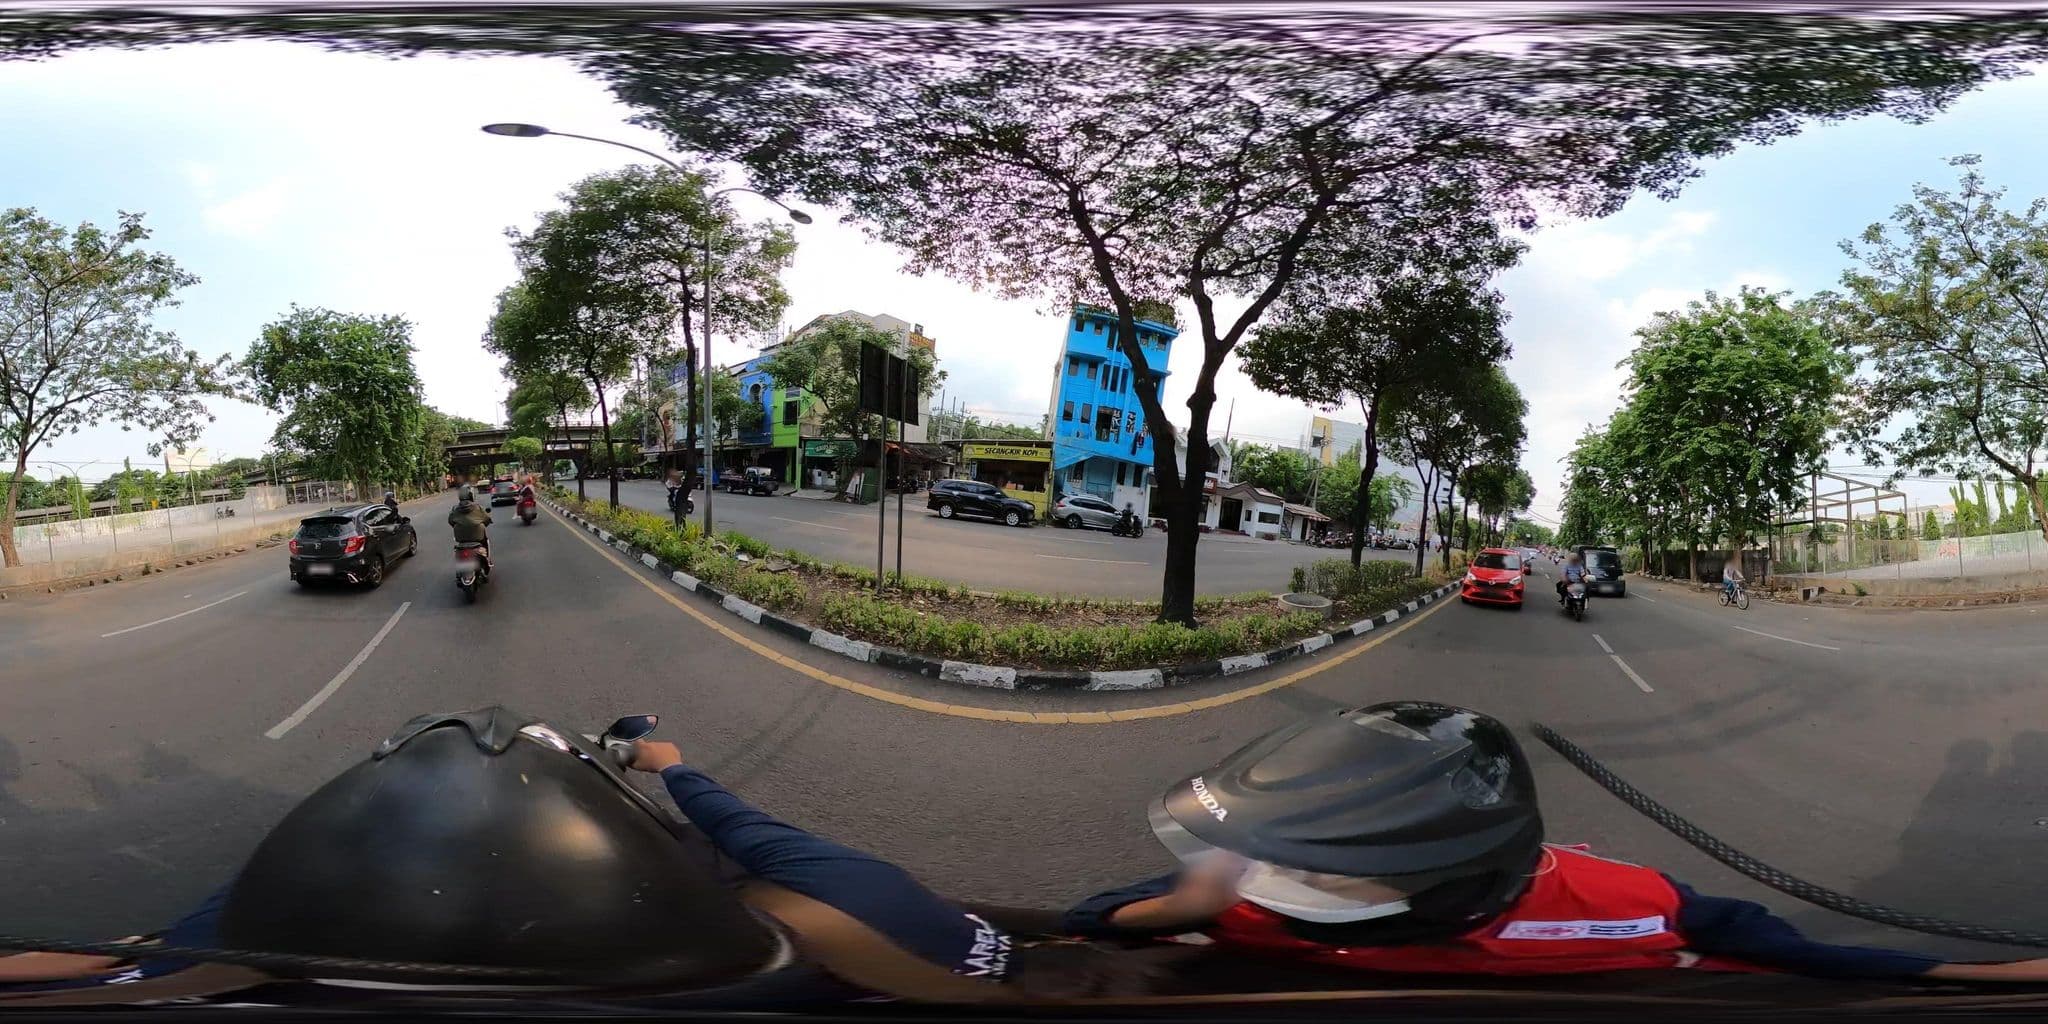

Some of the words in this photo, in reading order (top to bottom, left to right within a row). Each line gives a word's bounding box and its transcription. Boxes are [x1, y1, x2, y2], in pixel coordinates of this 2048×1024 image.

[984, 447, 1021, 456] SECANGKIR
[1022, 449, 1039, 457] KOPI
[1191, 776, 1228, 822] HONDA
